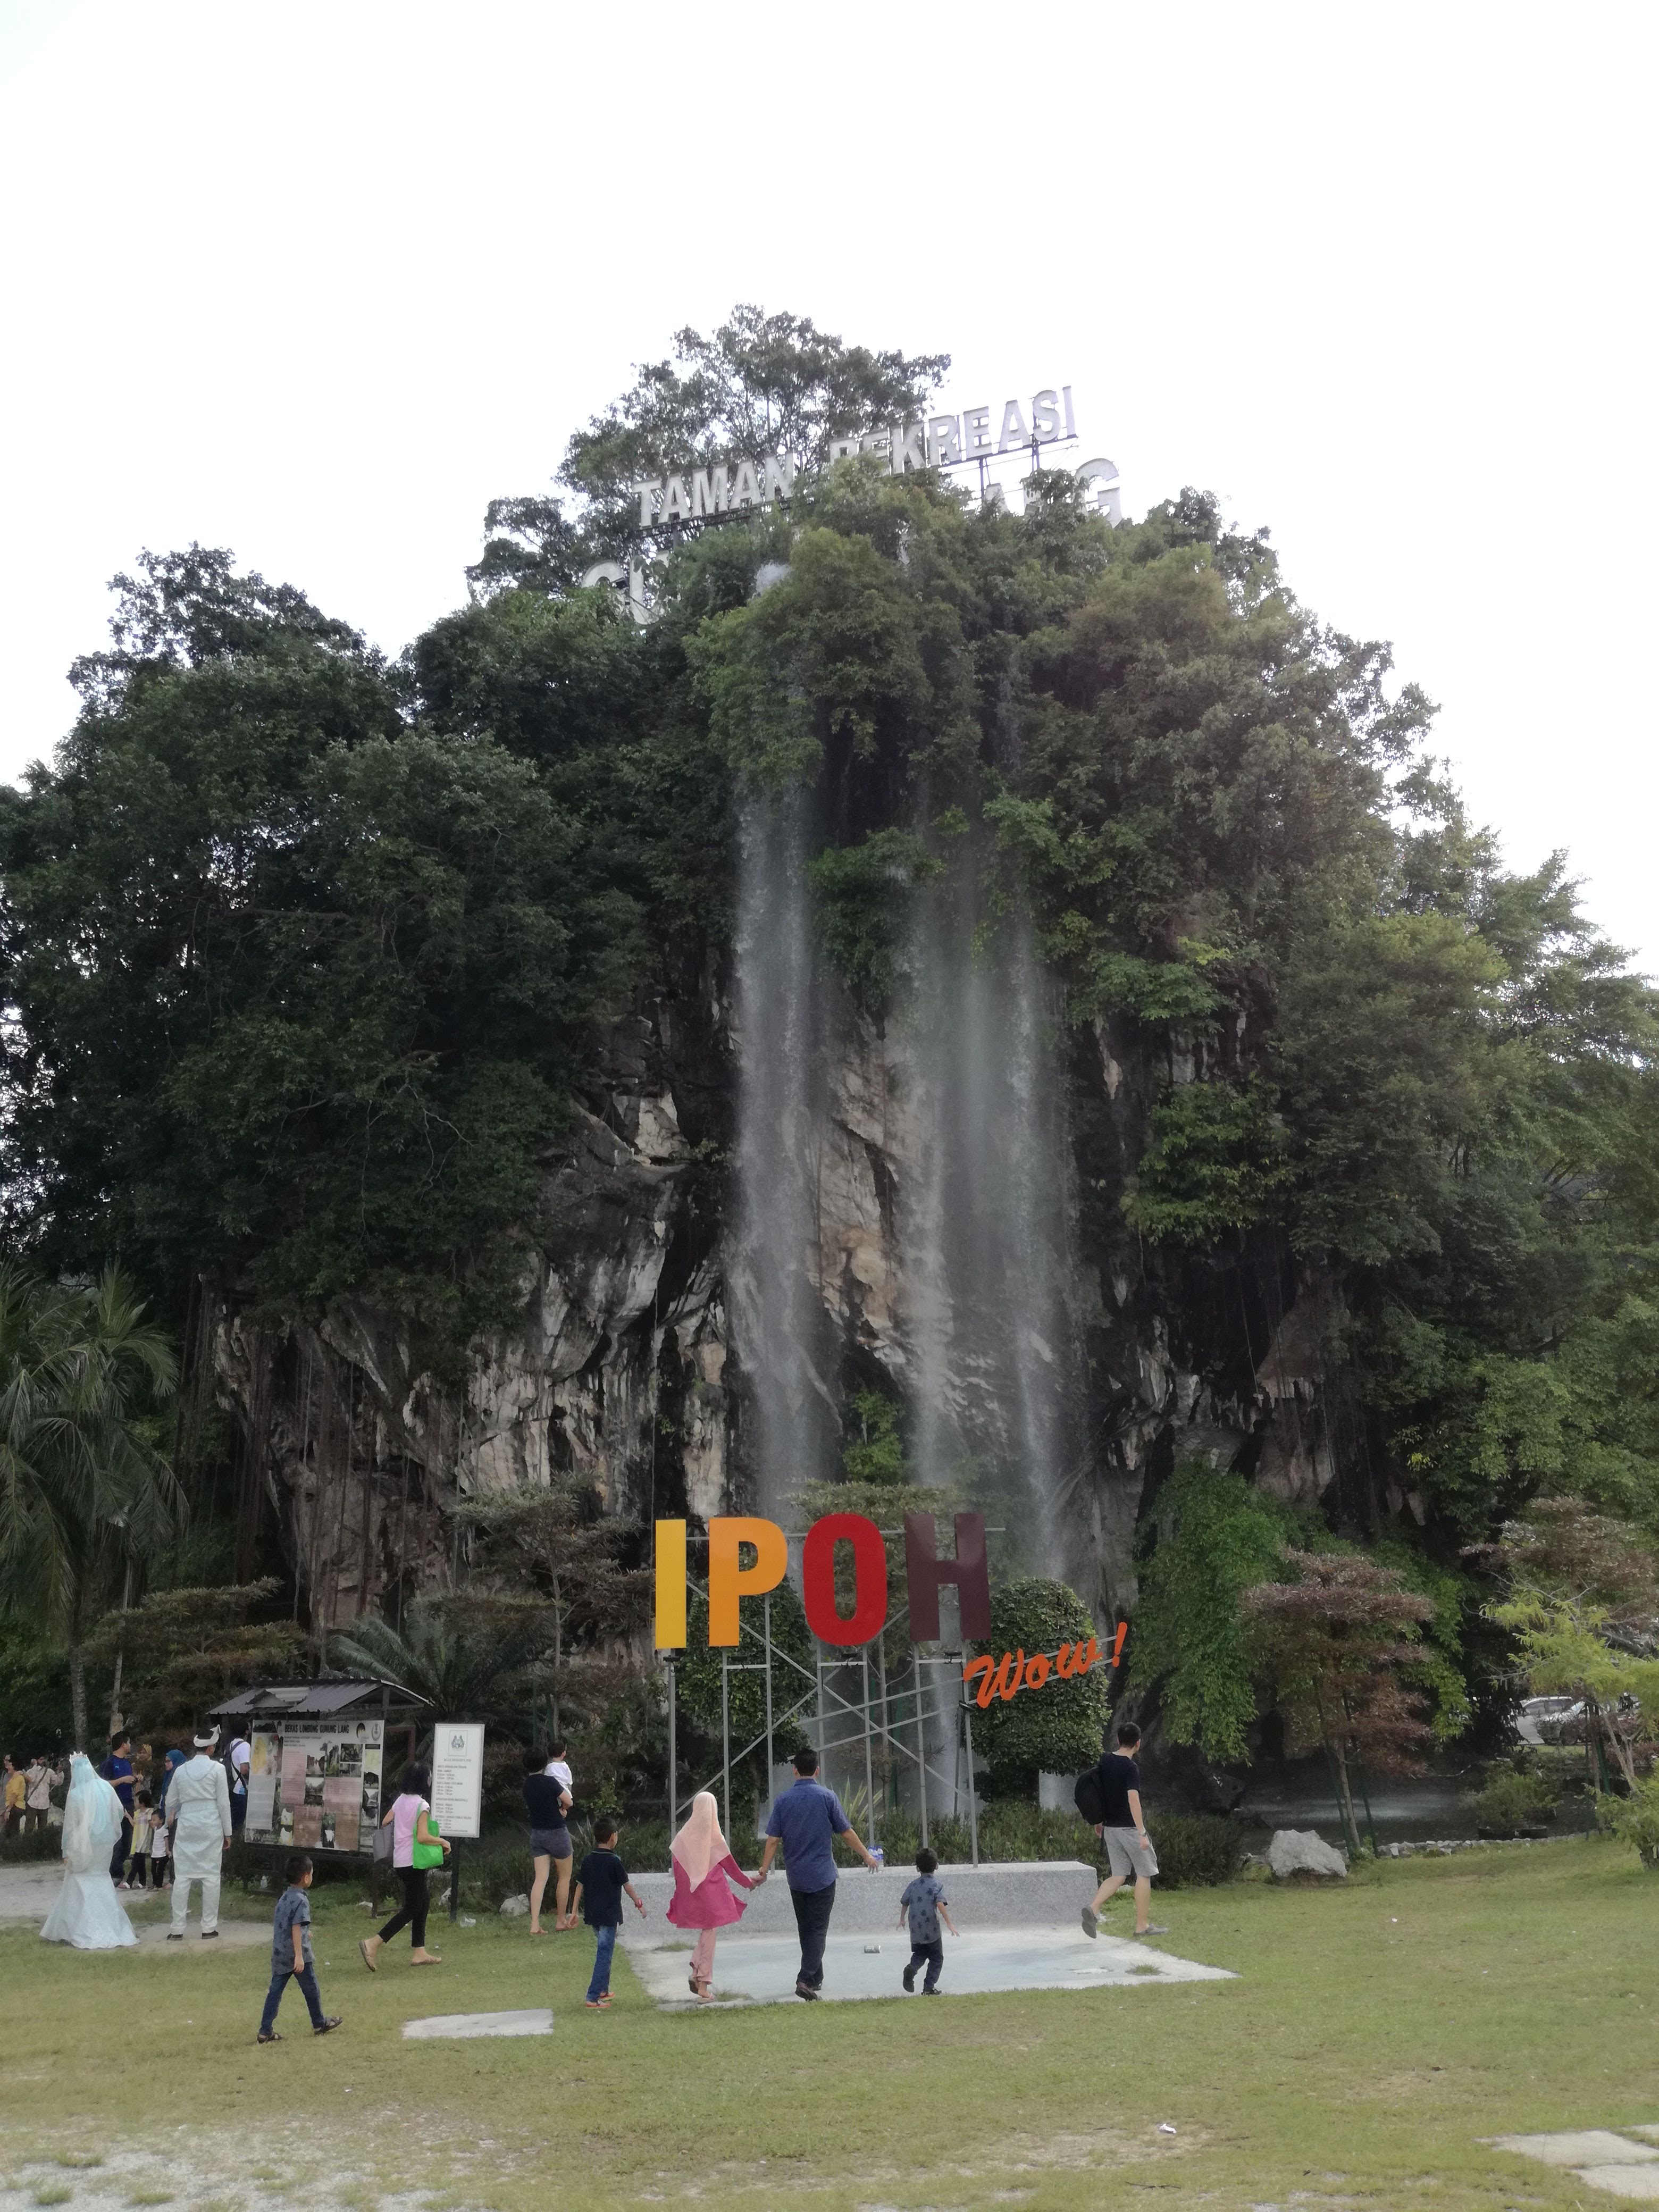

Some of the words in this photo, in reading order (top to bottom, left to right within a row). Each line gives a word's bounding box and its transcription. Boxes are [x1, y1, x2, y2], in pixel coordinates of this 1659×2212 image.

[632, 450, 794, 529] TAMAN
[655, 1513, 991, 1649] IPOH
[284, 1724, 298, 1732] BEKAS
[299, 1724, 318, 1733] LOMBONG
[320, 1725, 336, 1733] GUNUNG
[338, 1725, 349, 1733] LANG
